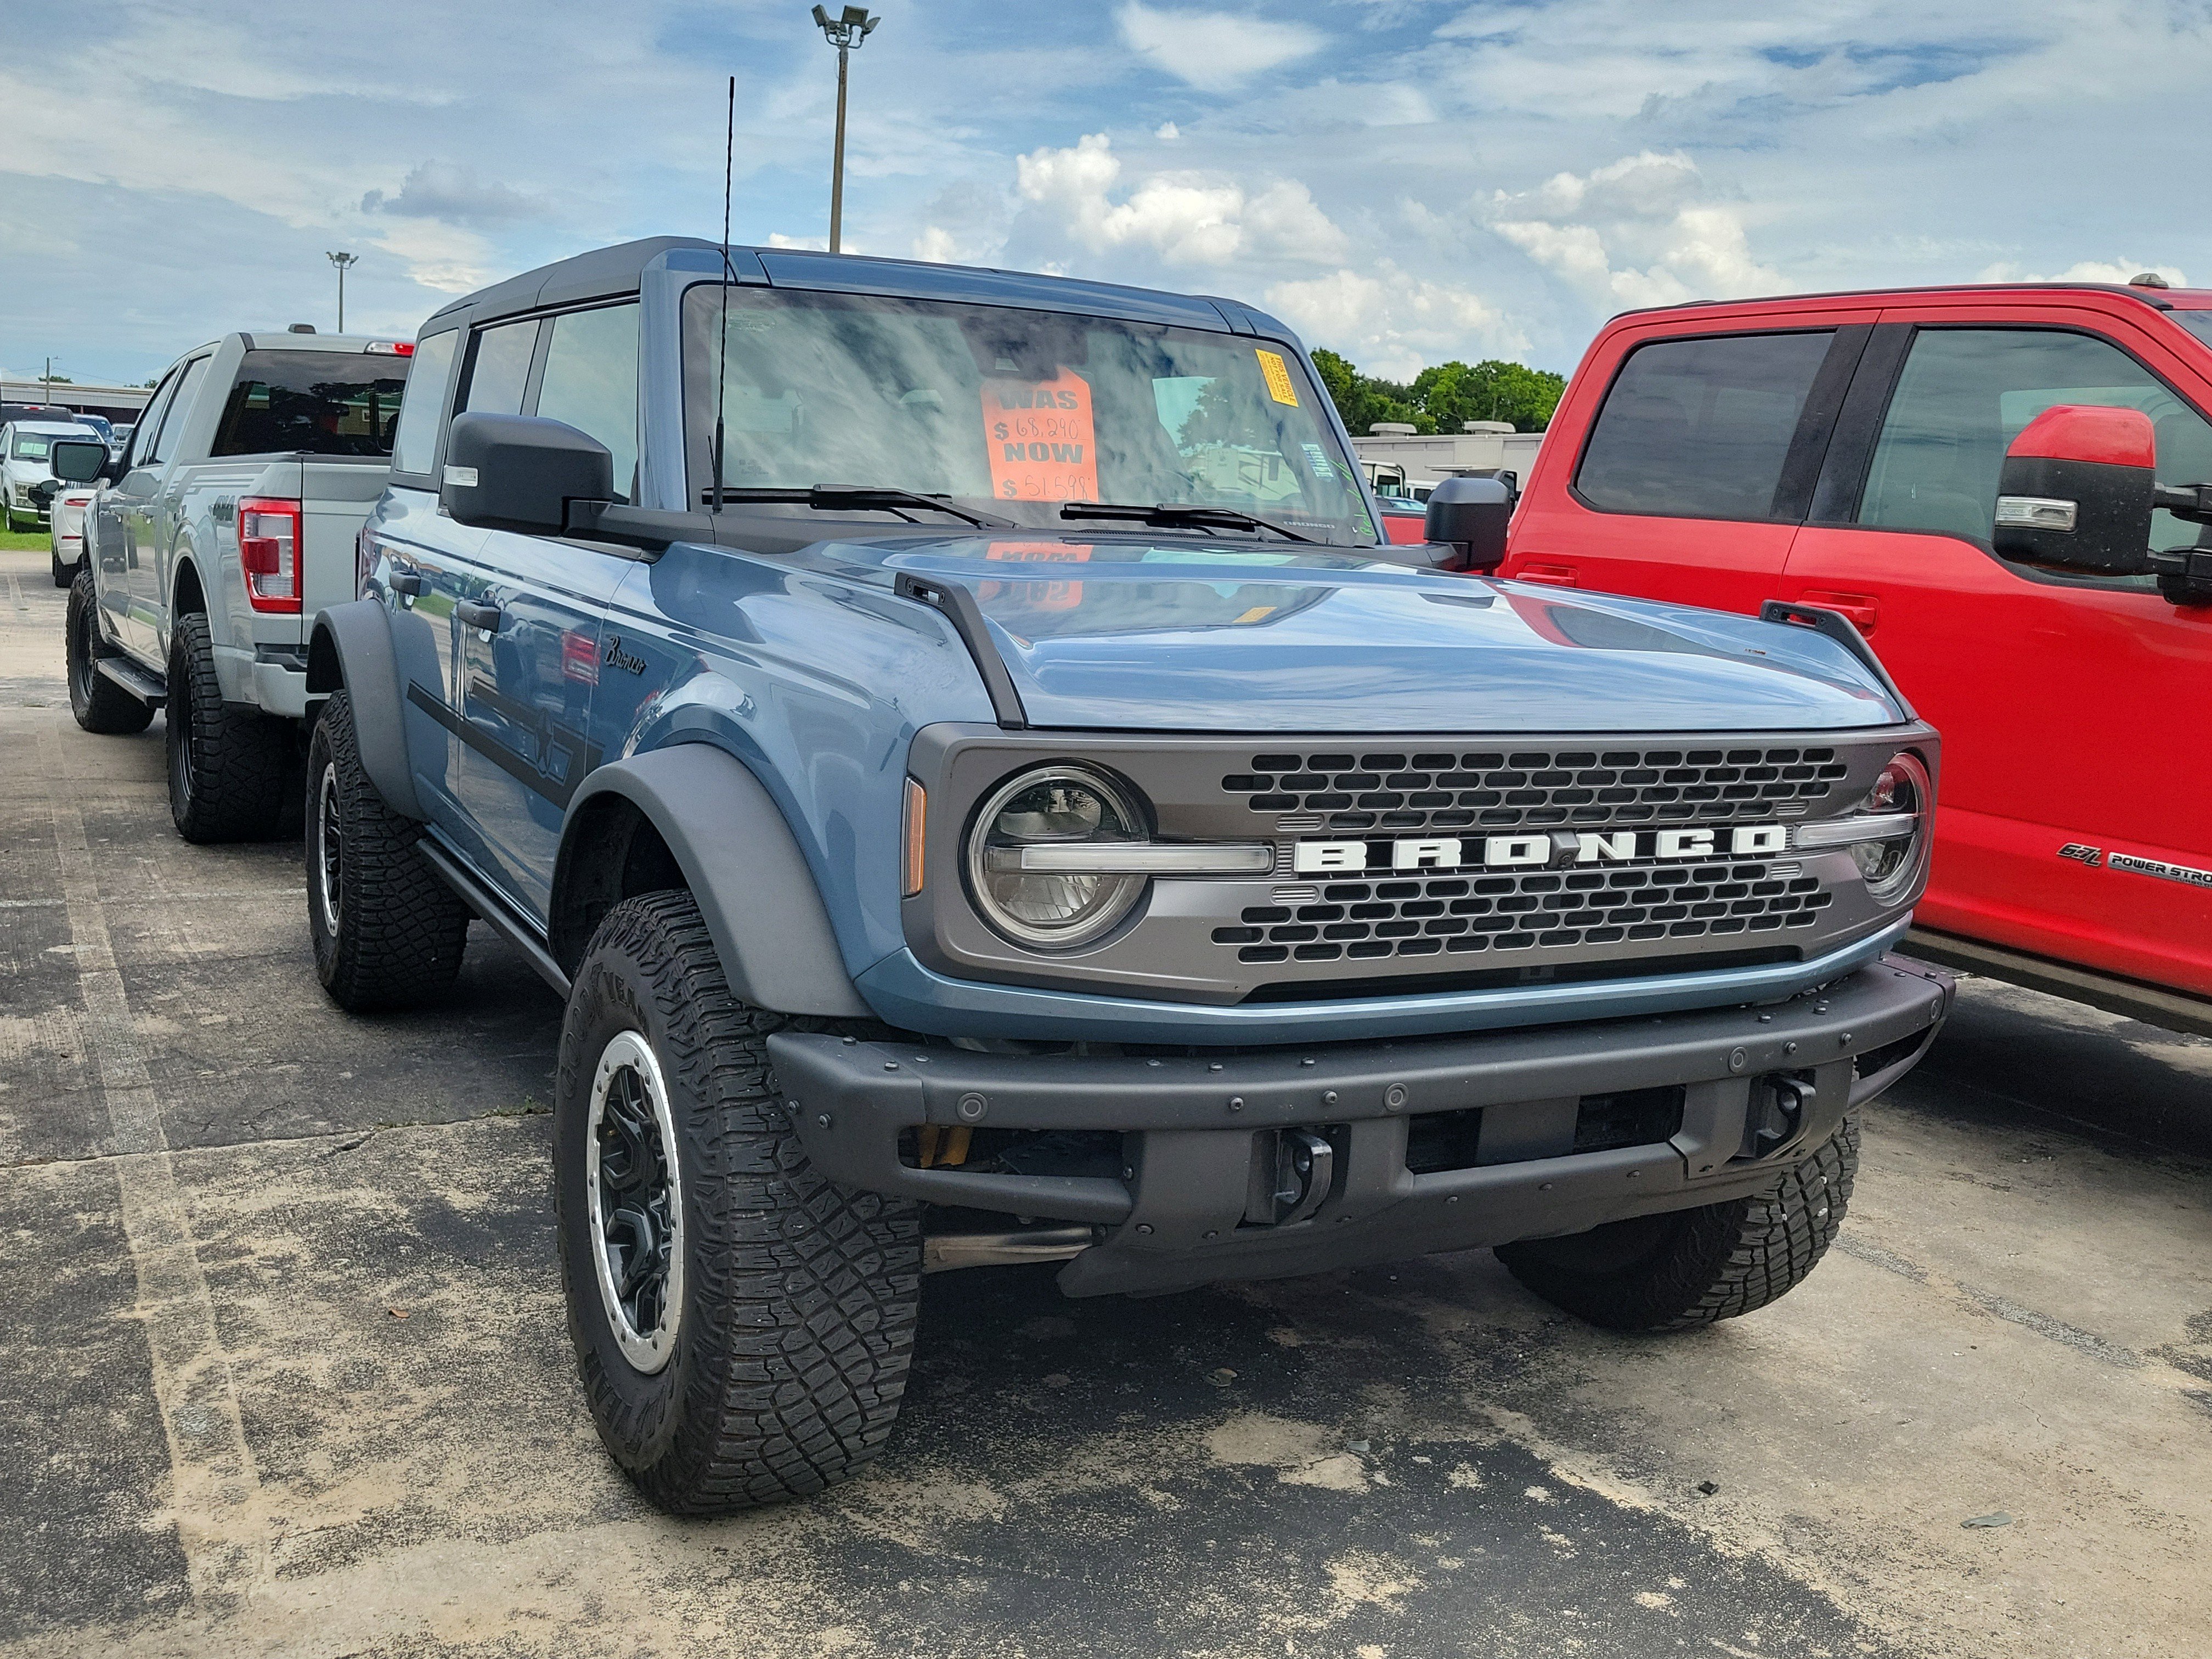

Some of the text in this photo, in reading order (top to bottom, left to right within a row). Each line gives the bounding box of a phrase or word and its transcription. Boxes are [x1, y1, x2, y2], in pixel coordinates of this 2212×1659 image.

[1274, 370, 1283, 382] FOR
[1275, 357, 1296, 403] THIS VEHICLE
[997, 390, 1079, 410] WAS
[994, 422, 1009, 441] $
[1003, 442, 1084, 465] NOW
[1002, 479, 1018, 498] $
[604, 635, 648, 675] Bronco
[1294, 825, 1786, 872] BRONCO
[2112, 855, 2165, 873] POWER
